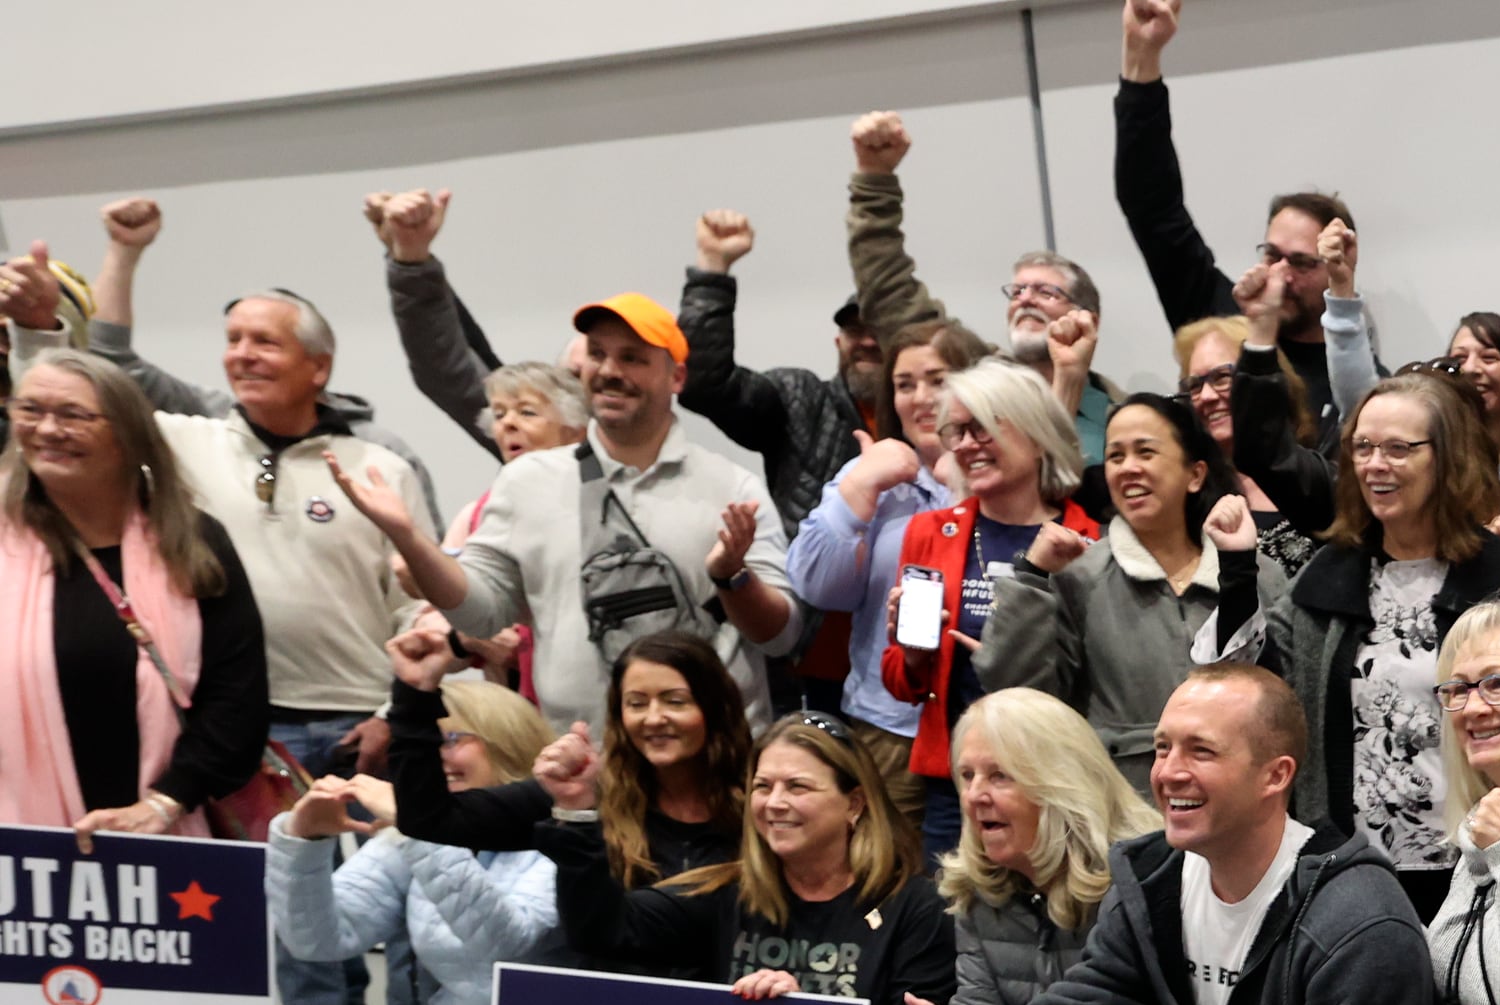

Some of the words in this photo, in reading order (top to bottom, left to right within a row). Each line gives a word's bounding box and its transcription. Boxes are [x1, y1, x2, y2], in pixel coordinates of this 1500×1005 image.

[0, 920, 74, 958] HTS
[85, 925, 192, 966] BACK!
[733, 931, 861, 973] HONOR
